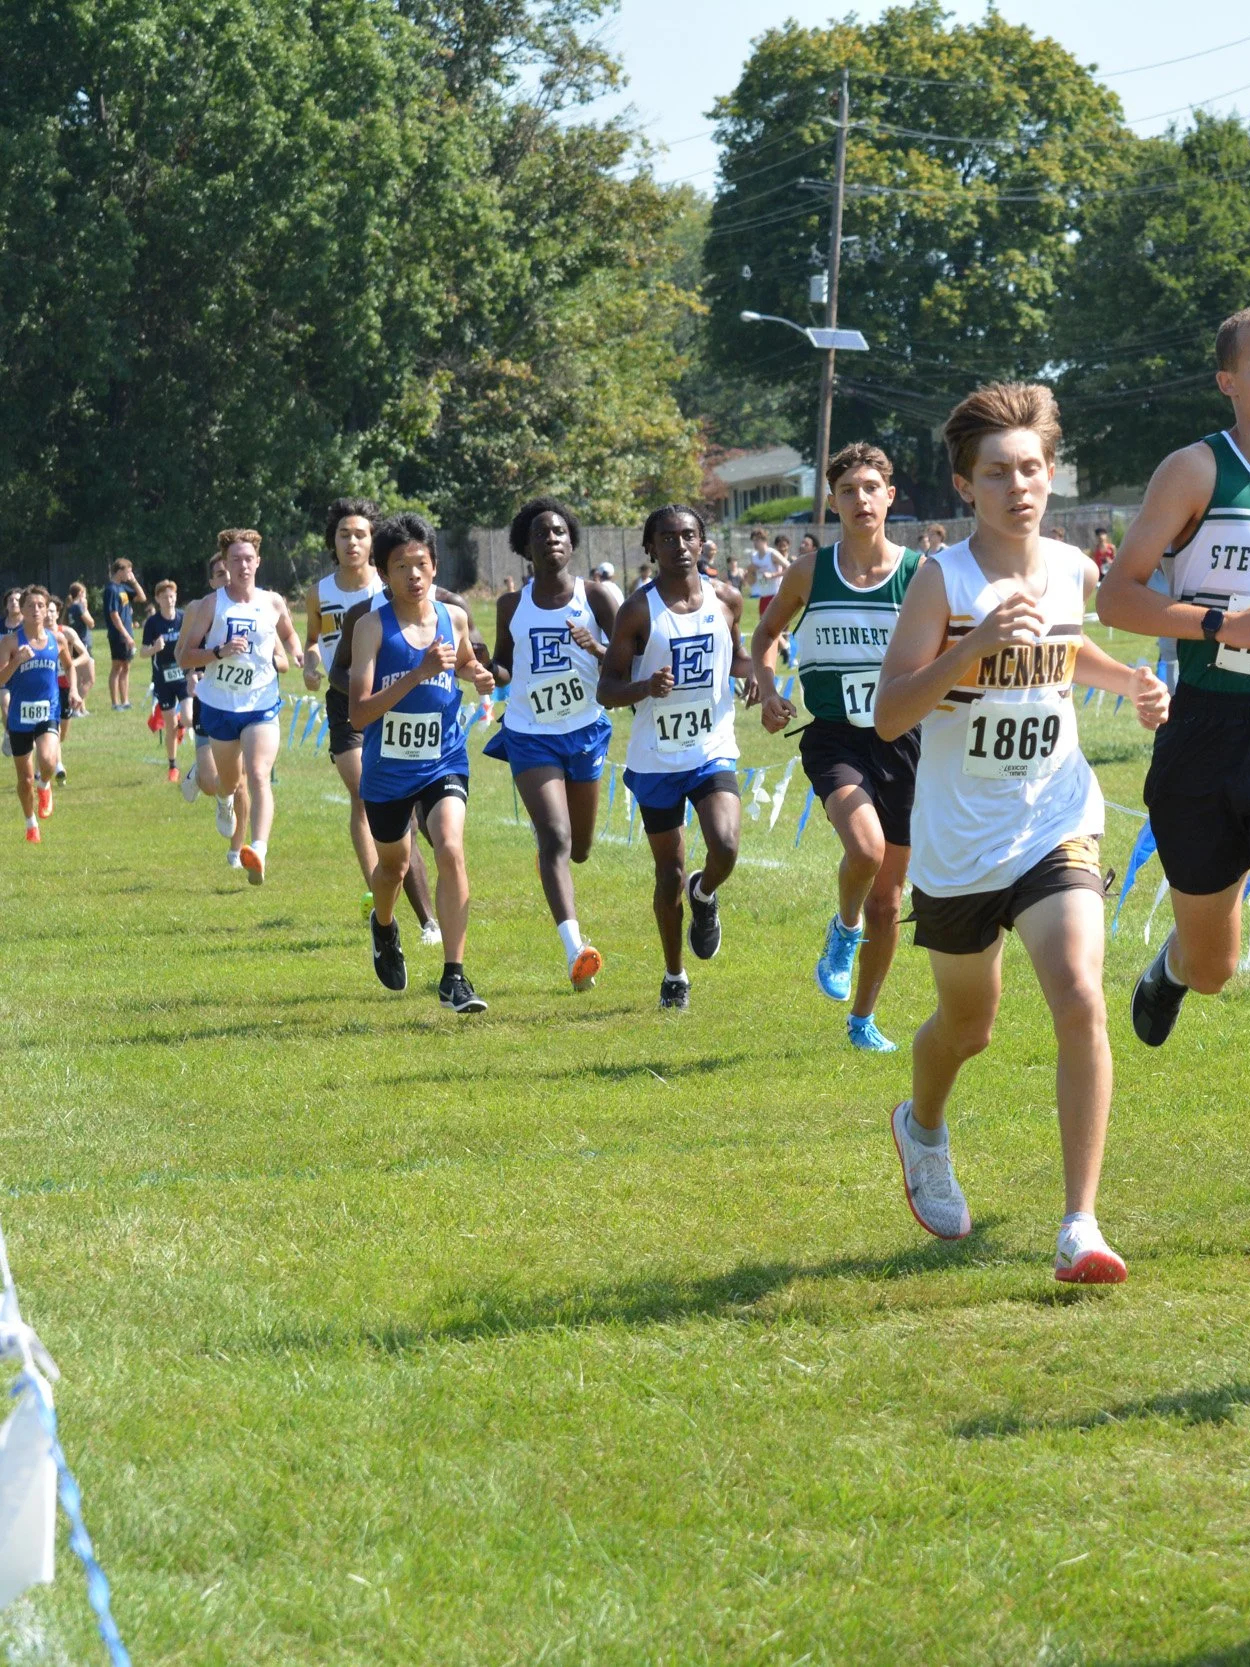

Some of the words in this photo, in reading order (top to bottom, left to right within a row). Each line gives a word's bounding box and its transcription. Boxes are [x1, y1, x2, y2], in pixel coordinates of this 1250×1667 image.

[529, 628, 572, 674] E
[815, 626, 889, 645] STEINERT
[216, 664, 254, 686] 1728
[669, 633, 714, 690] E
[22, 705, 48, 719] 1681
[530, 677, 585, 715] 1736
[384, 720, 440, 748] 1699
[656, 708, 713, 741] 1734
[968, 714, 1061, 761] 1869
